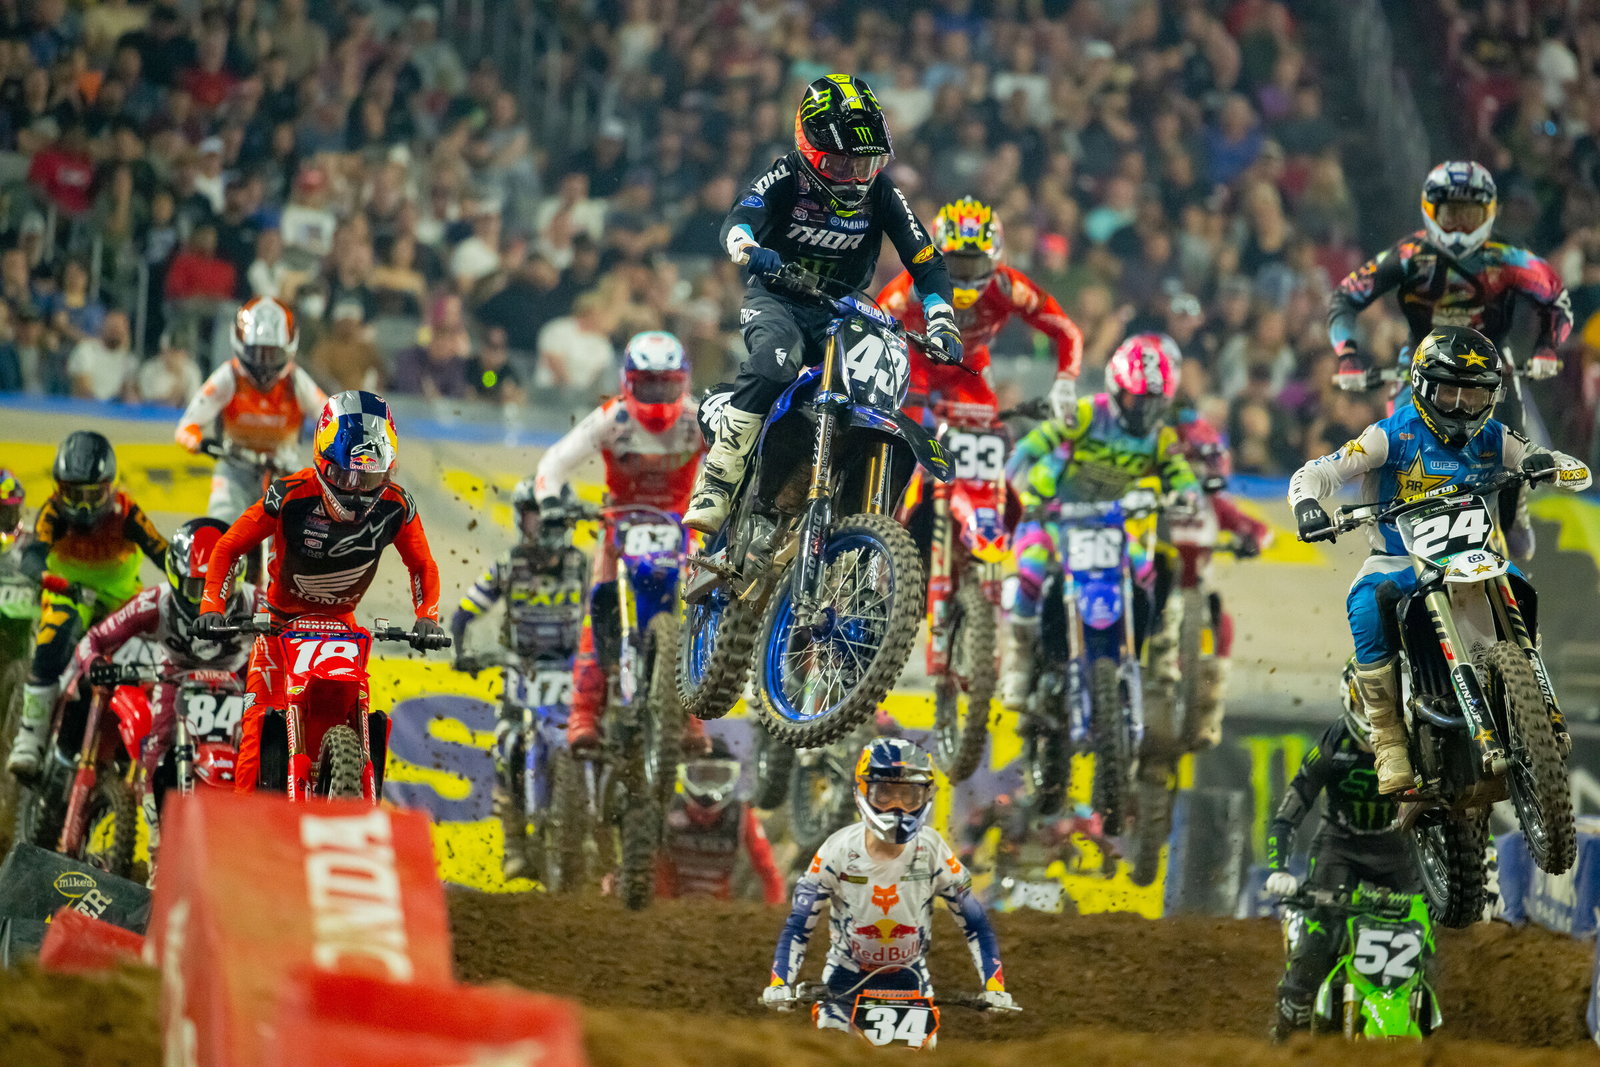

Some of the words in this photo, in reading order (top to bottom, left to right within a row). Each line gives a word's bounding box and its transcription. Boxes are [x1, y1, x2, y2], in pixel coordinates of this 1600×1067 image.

[752, 164, 791, 196] THOR
[786, 223, 865, 250] THOR
[841, 219, 869, 230] YAMAHA
[847, 333, 908, 397] 43
[950, 433, 1005, 480] 33
[1430, 461, 1459, 470] WPS
[1302, 509, 1322, 522] FLY
[303, 529, 328, 539] SHOWA
[624, 525, 681, 556] 83
[807, 512, 824, 580] DUNLOP
[1413, 509, 1489, 558] 24
[413, 574, 425, 607] ONDA
[293, 641, 359, 674] 18
[1454, 673, 1482, 723] DUNLOP
[184, 694, 243, 736] 84
[59, 877, 93, 888] mike's
[300, 811, 413, 982] ONDA
[852, 940, 884, 962] Red
[888, 940, 919, 962] Bull
[1353, 930, 1421, 979] 52
[864, 1008, 929, 1047] 34
